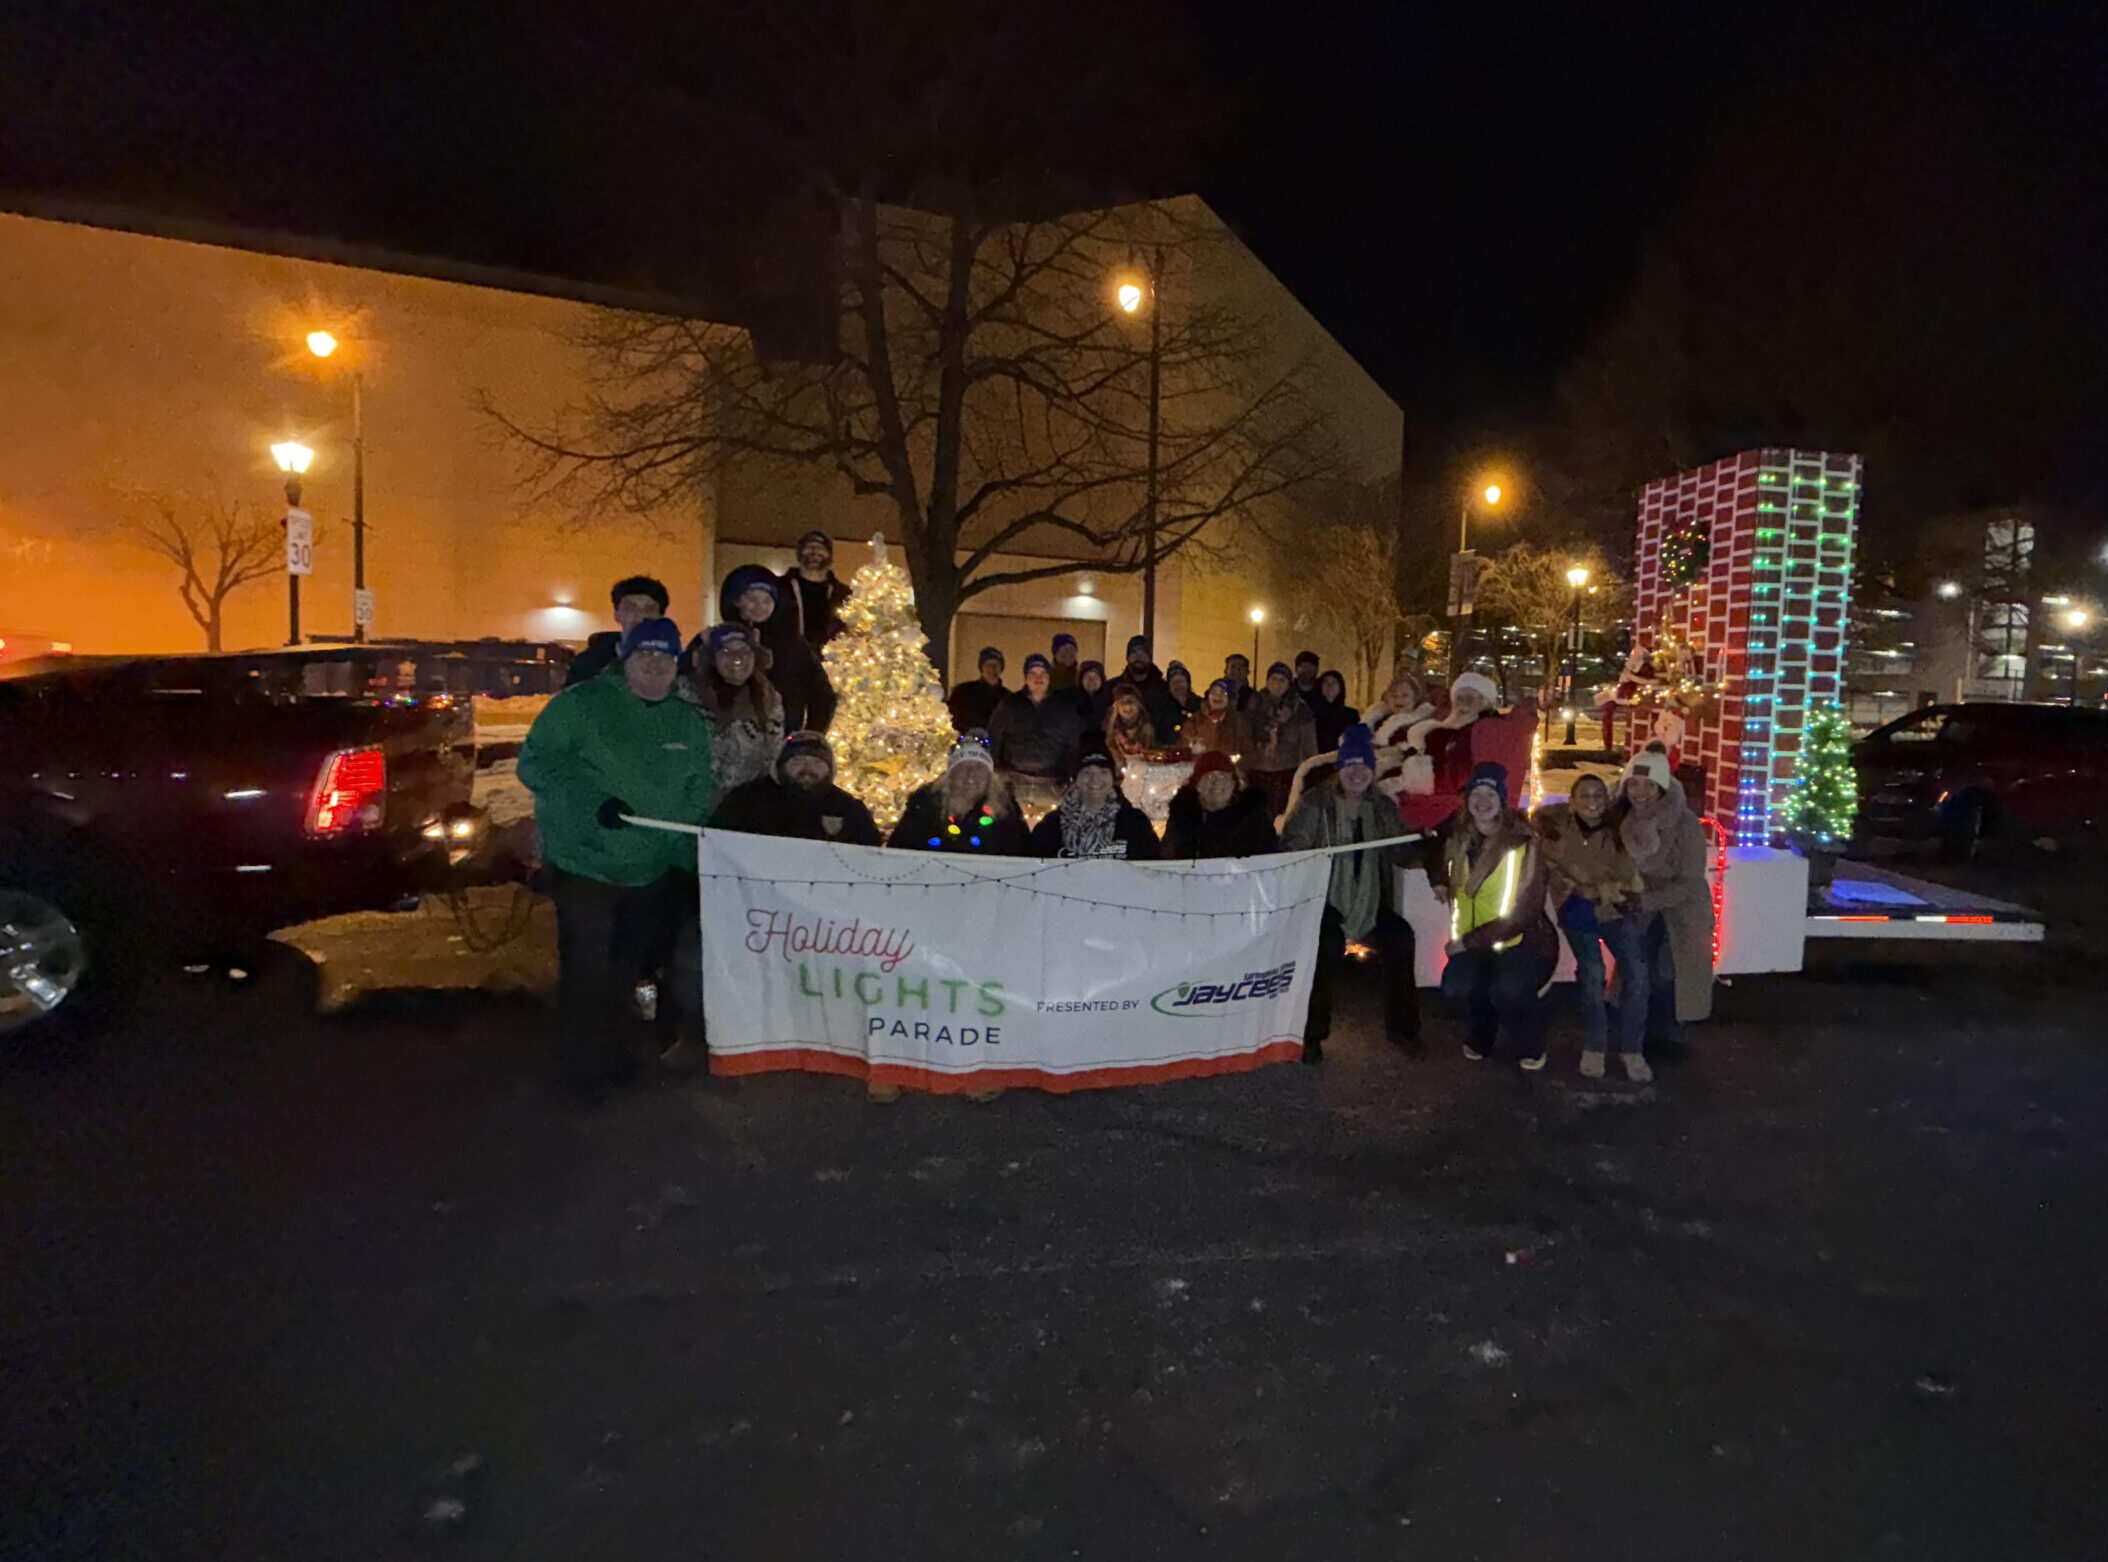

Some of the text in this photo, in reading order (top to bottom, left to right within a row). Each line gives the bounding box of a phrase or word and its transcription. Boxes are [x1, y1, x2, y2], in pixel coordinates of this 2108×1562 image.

[291, 543, 312, 569] 30
[746, 908, 915, 973] Holiday
[800, 963, 1005, 1017] LIGHTS
[1037, 1000, 1140, 1013] PRESENTED BY
[868, 1017, 1001, 1046] PARADE
